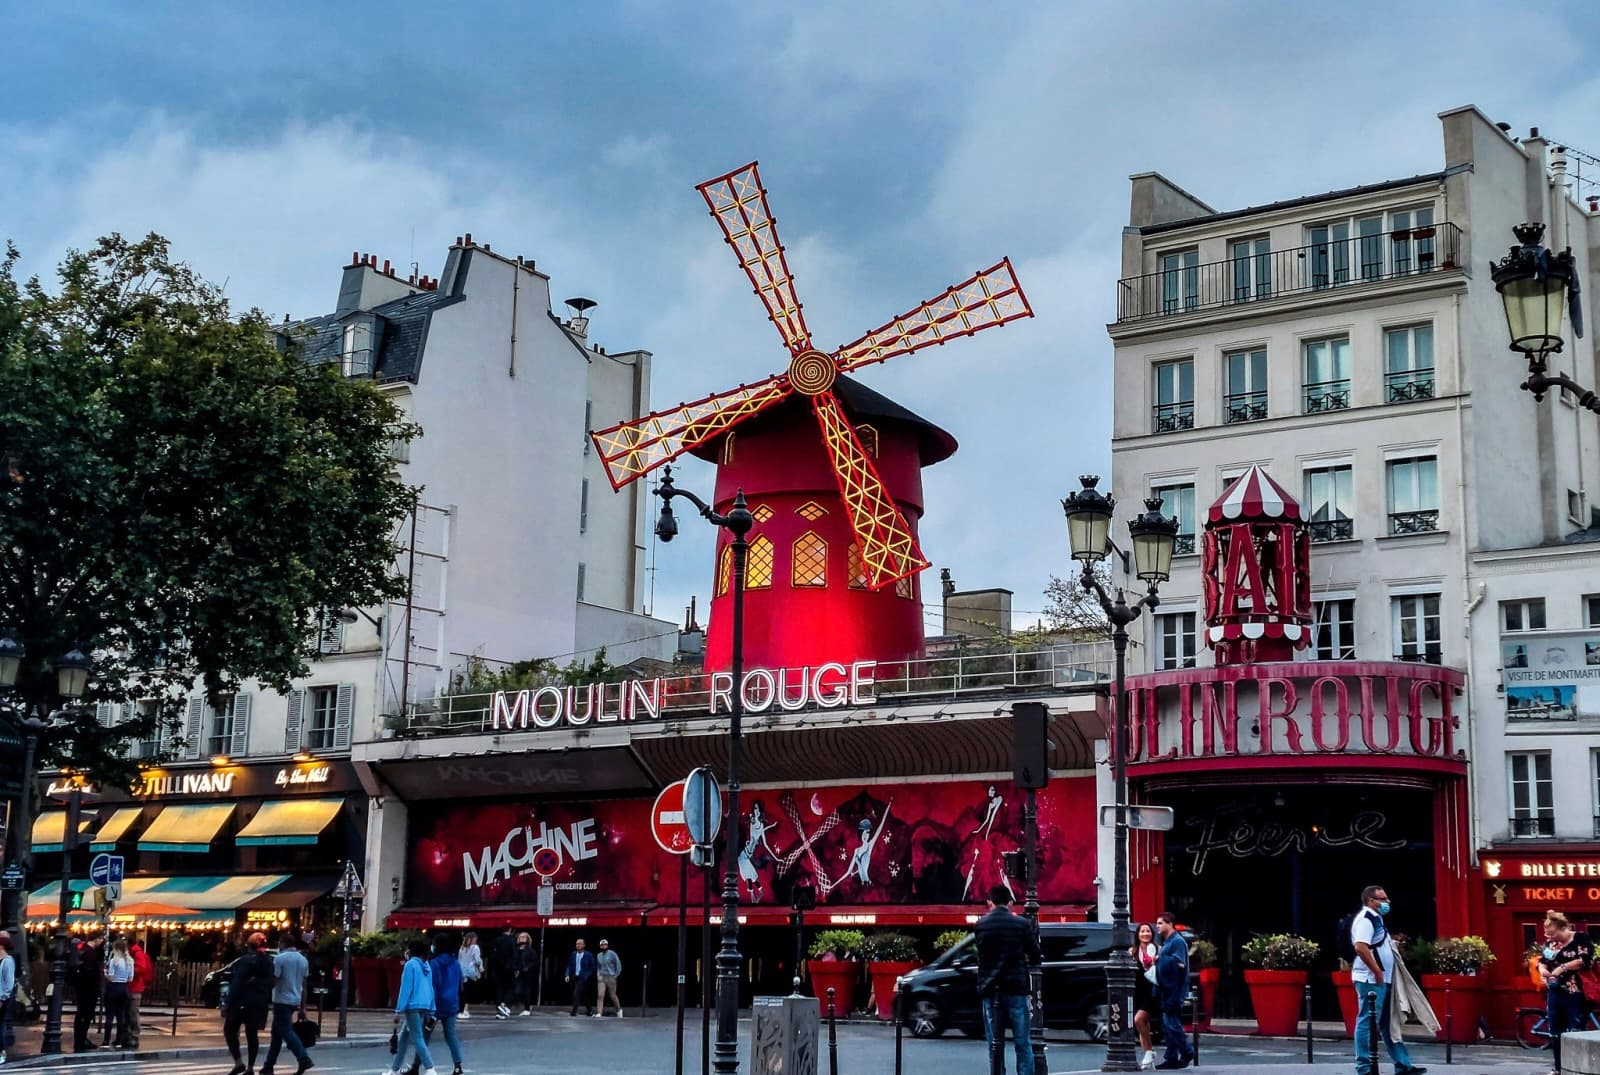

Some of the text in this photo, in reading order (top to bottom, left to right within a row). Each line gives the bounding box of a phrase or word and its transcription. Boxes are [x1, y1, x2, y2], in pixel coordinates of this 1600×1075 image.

[1215, 639, 1258, 665] DU
[1507, 668, 1600, 681] VISITE DE MONTMART
[493, 660, 877, 730] MOULIN ROUGE
[1258, 675, 1466, 759] ROUGE
[275, 769, 290, 789] By
[1522, 863, 1600, 877] BILLETTE
[1523, 887, 1600, 900] TICKET O
